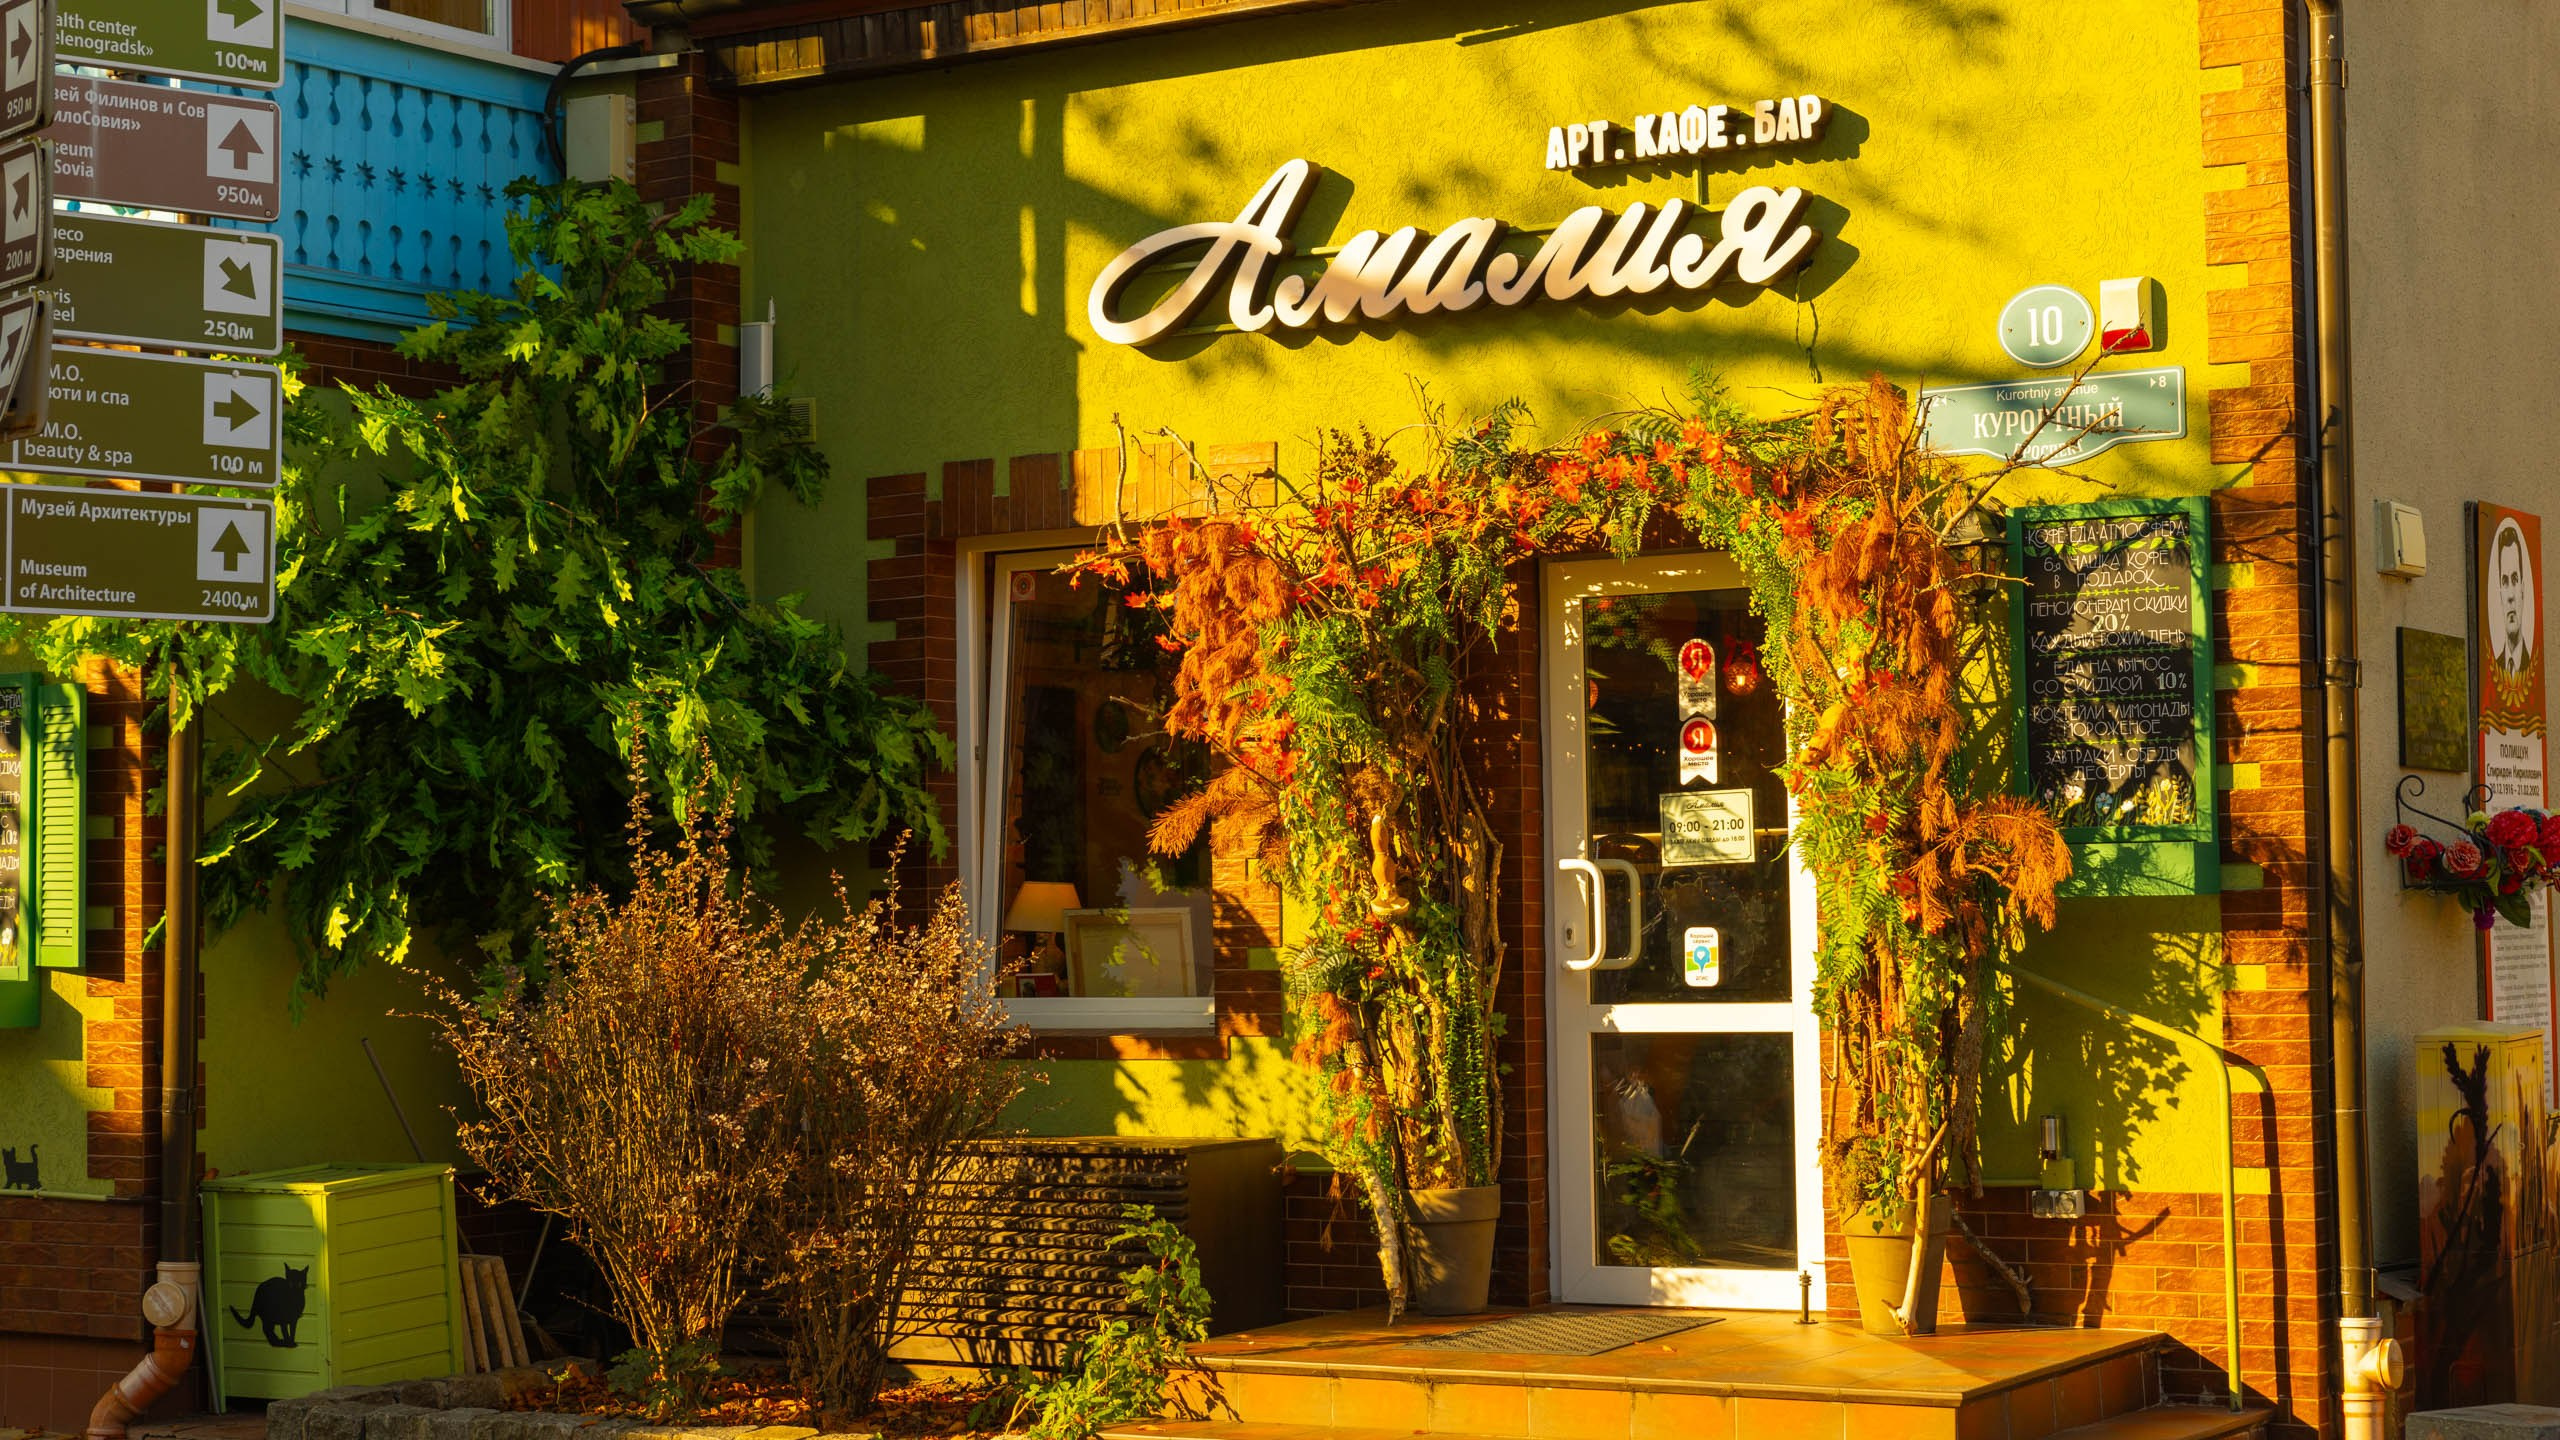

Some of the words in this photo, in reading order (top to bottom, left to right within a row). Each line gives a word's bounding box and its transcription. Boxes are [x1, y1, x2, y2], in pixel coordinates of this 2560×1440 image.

[55, 11, 84, 30] alth
[88, 19, 137, 37] center
[55, 29, 154, 57] lenogradsk»
[215, 50, 248, 71] 100
[6, 96, 25, 120] 950
[54, 85, 80, 103] зей
[84, 88, 158, 113] Филинов
[162, 102, 173, 115] и
[177, 101, 206, 119] Сов
[1754, 94, 1823, 143] БАР
[5, 248, 23, 272] 200
[54, 246, 113, 264] зрения
[1087, 158, 1814, 347] Амалия
[53, 306, 75, 323] eel
[2027, 305, 2063, 348] 10
[48, 386, 82, 401] юти
[86, 389, 97, 403] и
[101, 390, 130, 406] спа
[1996, 385, 2051, 402] Kurortniy
[25, 438, 84, 465] beauty
[87, 444, 101, 462] &
[104, 449, 133, 468] spa
[210, 454, 243, 473] 100
[21, 496, 76, 519] Музей
[79, 501, 192, 527] Архитектуры
[20, 558, 88, 578] Museum
[2070, 552, 2121, 571] ЧАШКА
[2127, 549, 2169, 571] КОФЕ
[2053, 574, 2061, 589] В
[2076, 569, 2166, 588] ПОДАРОК
[19, 582, 37, 599] of
[39, 583, 136, 603] Architecture
[201, 589, 243, 609] 2400
[2030, 597, 2130, 617] ПЕНСИОНЕРАМ
[2133, 594, 2188, 615] СКИДКИ
[2091, 612, 2131, 633] 20%
[2100, 629, 2145, 647] БОЖИЙ
[2146, 628, 2186, 646] ДЕНЬ
[2053, 660, 2085, 676] ЕДА
[2089, 658, 2112, 675] НА
[2117, 655, 2171, 673] ВЫНОС
[2032, 678, 2059, 695] СО
[2063, 674, 2143, 696] СКИДКОЙ
[2155, 672, 2188, 690] 10%
[2033, 703, 2105, 723] КОКТЕЙЛИ
[2115, 701, 2191, 719] ЛИМОНАДЫ
[1691, 727, 1704, 748] Я
[2063, 719, 2161, 737] МОРОЖЕНОЕ
[2045, 748, 2115, 765] ЗАВТРАКИ
[2126, 746, 2180, 763] ОБЕДЫ
[2499, 743, 2529, 760] ПОЛИЩУК
[2074, 764, 2146, 781] ДЕСЕРТЫ
[1669, 820, 1701, 834] 09:00
[1712, 818, 1745, 831] 21:00
